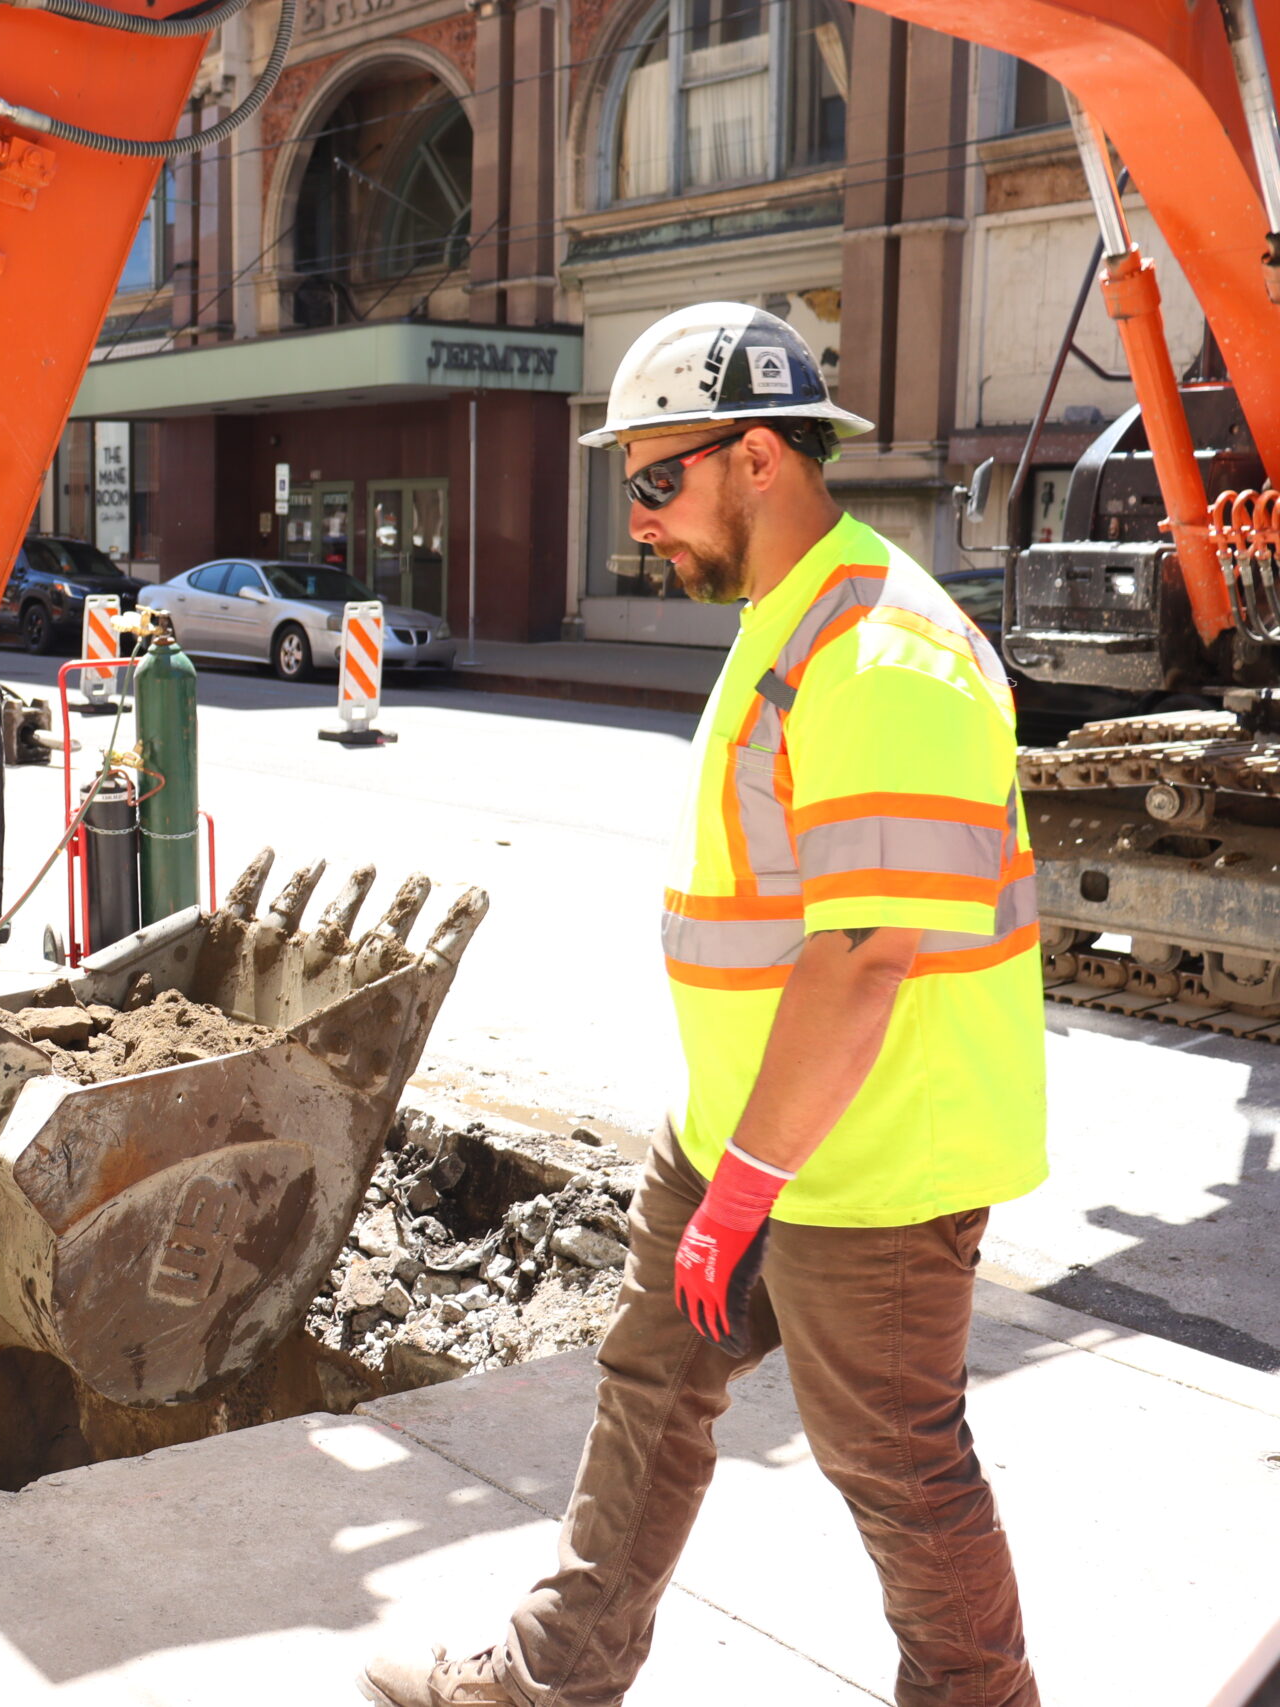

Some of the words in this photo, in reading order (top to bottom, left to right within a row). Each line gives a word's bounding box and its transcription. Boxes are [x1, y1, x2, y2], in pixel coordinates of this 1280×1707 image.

[427, 340, 558, 375] JERMYN
[103, 446, 121, 464] THE
[99, 468, 126, 485] MANE
[96, 489, 128, 506] ROOM
